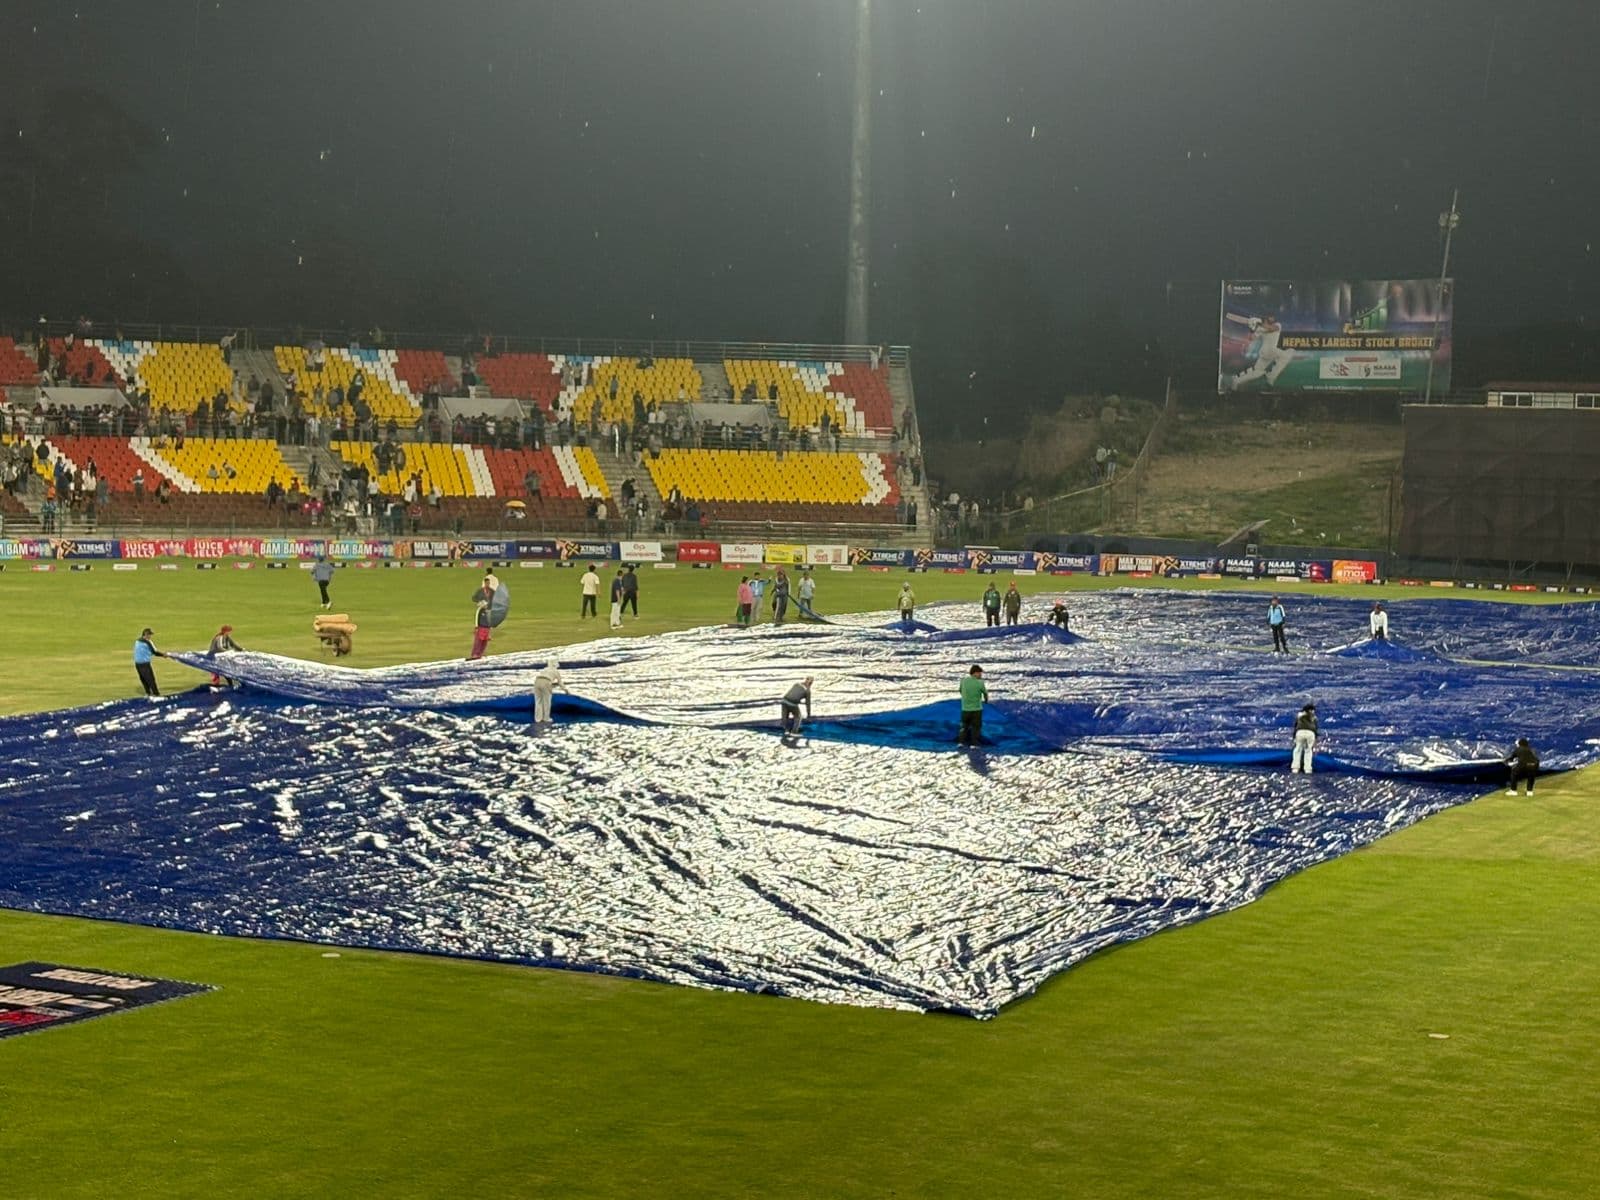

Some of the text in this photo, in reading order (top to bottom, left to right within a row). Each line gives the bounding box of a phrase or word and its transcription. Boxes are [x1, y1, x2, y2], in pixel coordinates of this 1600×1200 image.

[1282, 337, 1319, 347] NEPAL'S
[1322, 337, 1362, 347] LARGEST
[1365, 337, 1396, 347] STOCK
[7, 543, 29, 555] BAM
[77, 543, 105, 552] XTREME
[194, 541, 223, 550] JUICE
[260, 543, 304, 554] BAM BAM
[329, 543, 373, 555] BAM BAM
[126, 550, 155, 558] JELLY
[194, 549, 224, 558] JELLY
[1058, 557, 1084, 565] XTREME
[1136, 557, 1152, 565] TIGER
[1227, 559, 1254, 567] NAASA
